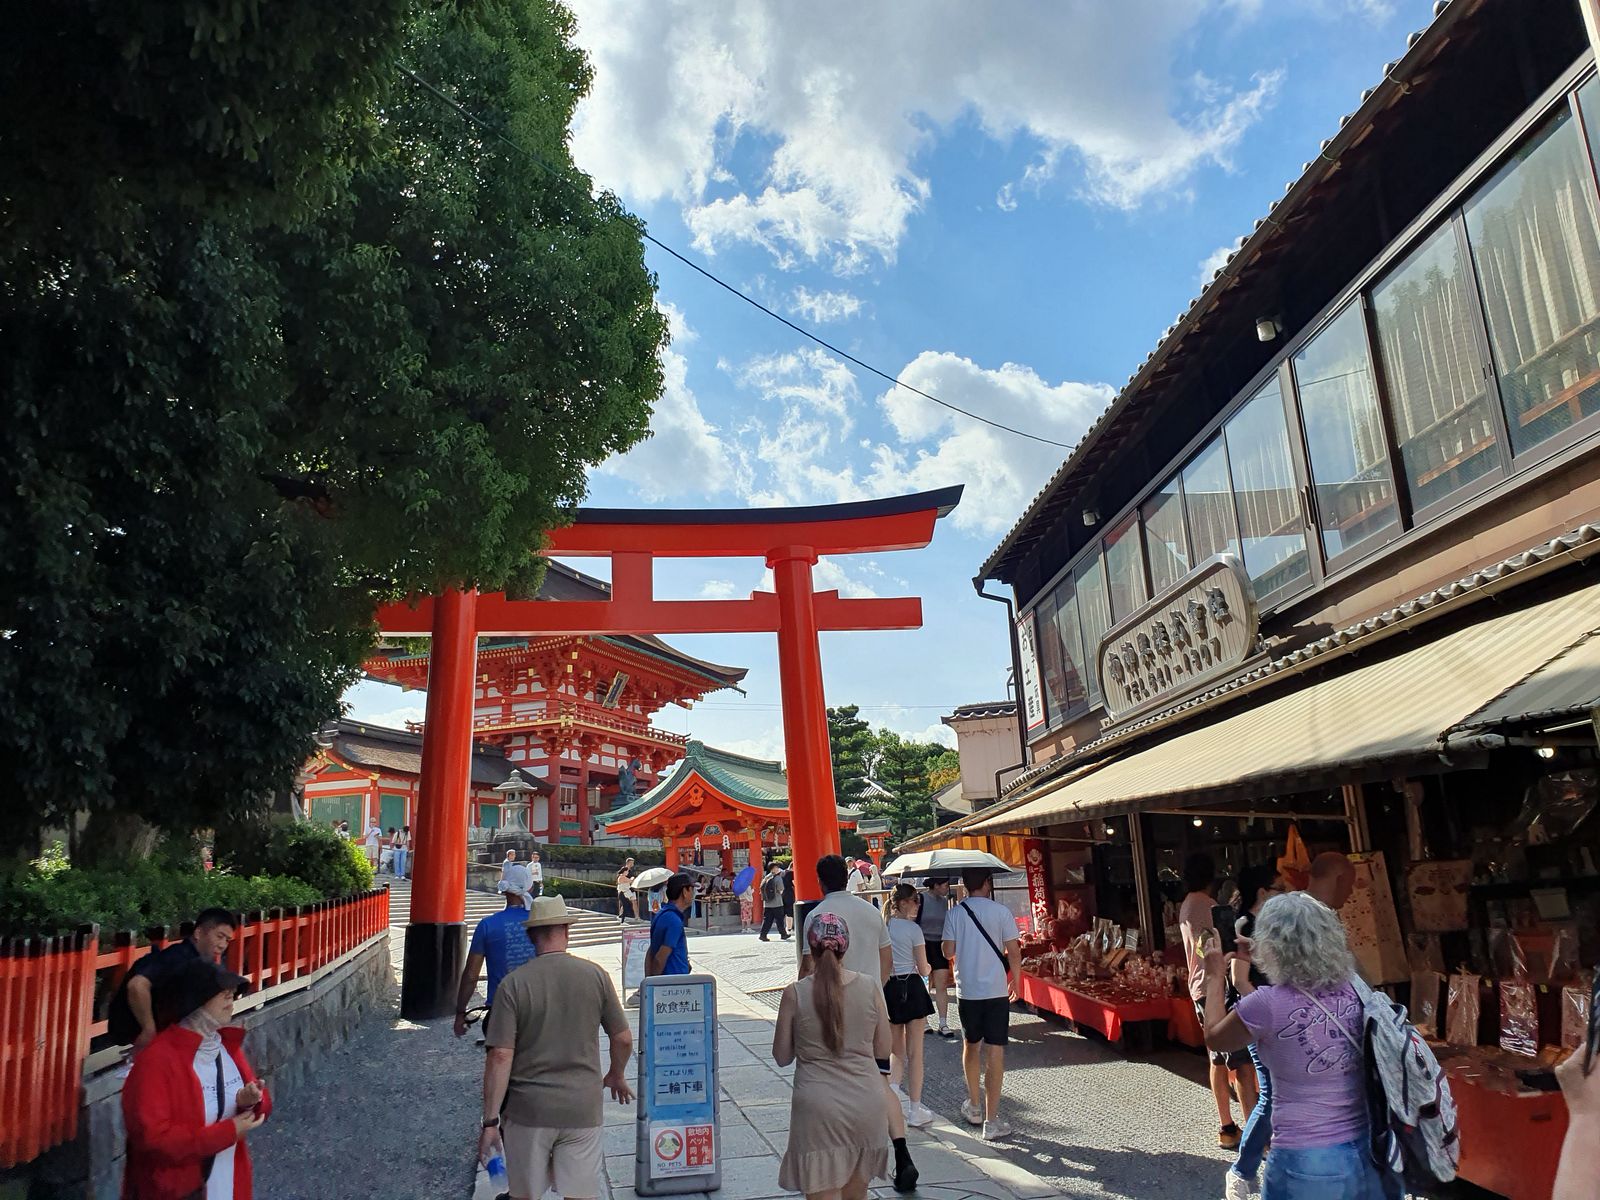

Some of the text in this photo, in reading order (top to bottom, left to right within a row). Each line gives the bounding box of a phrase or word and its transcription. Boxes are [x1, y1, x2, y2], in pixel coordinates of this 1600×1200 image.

[656, 1000, 702, 1014] 飲食禁止
[663, 1068, 694, 1077] これより先
[657, 1081, 703, 1095] 二輪下車
[689, 1136, 708, 1145] ペット
